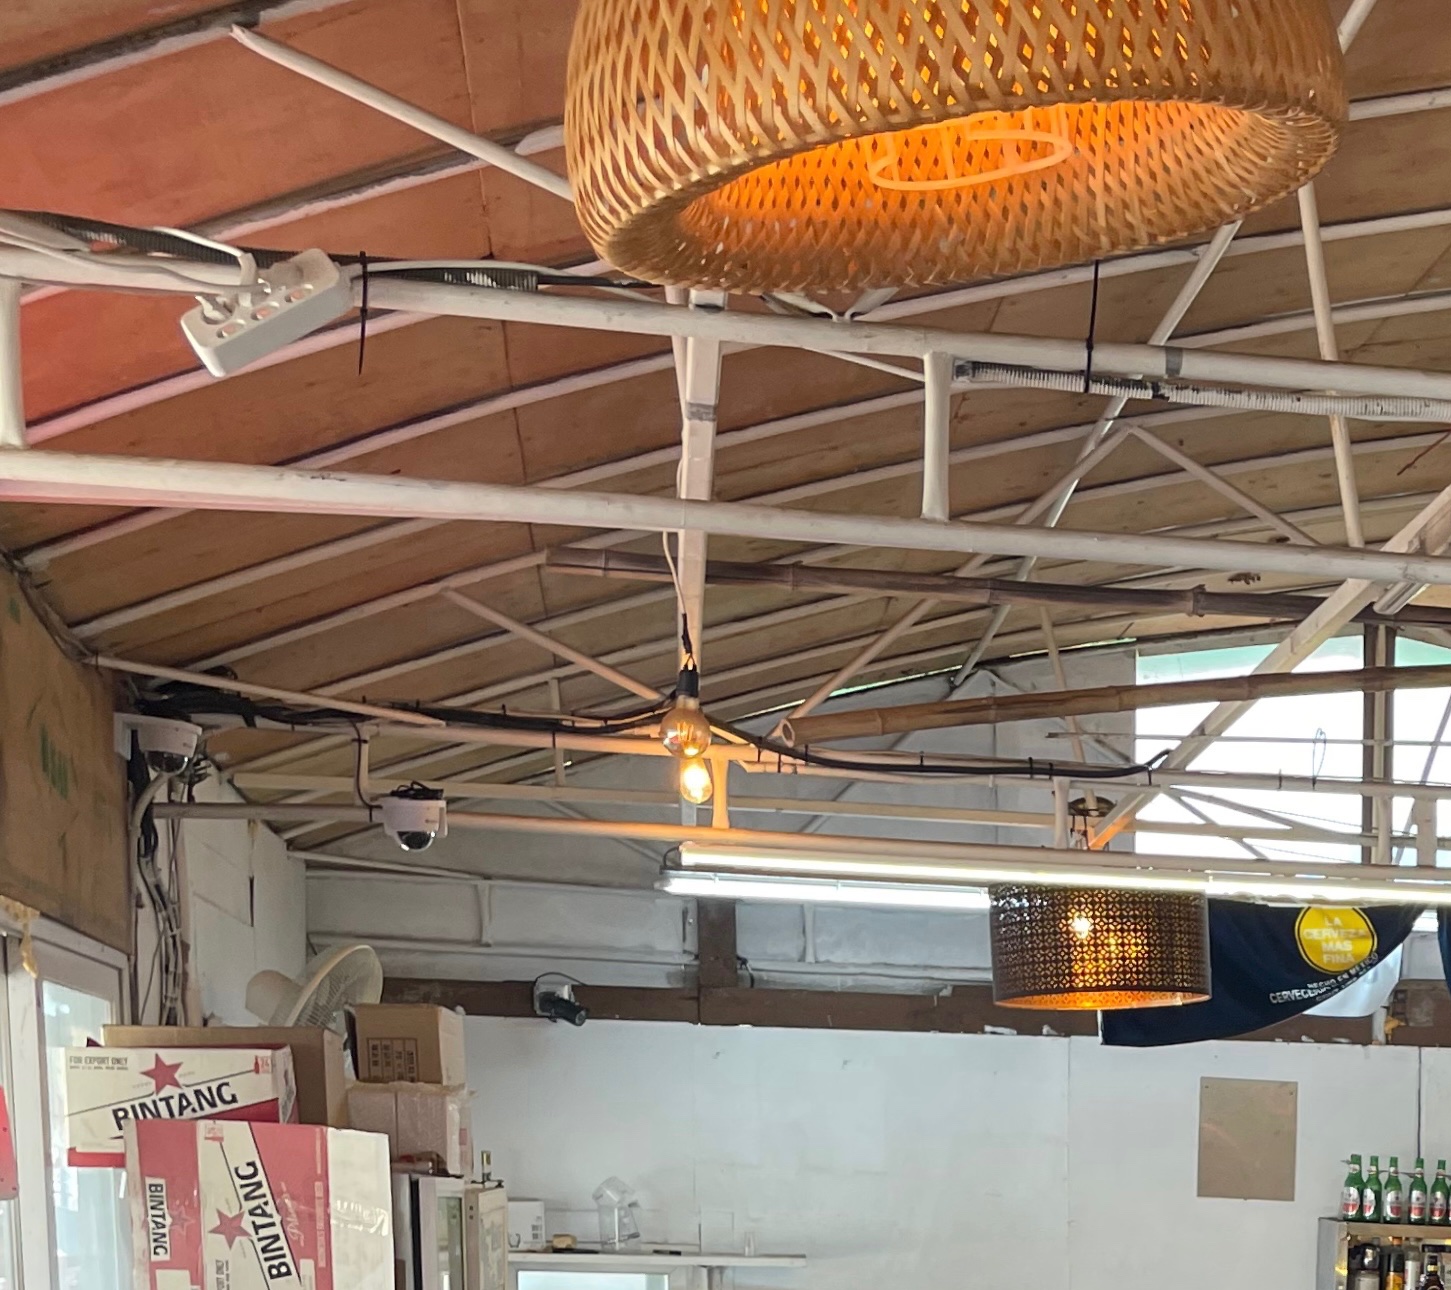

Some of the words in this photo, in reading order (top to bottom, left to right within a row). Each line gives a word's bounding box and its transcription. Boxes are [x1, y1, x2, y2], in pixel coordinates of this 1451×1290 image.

[112, 1082, 238, 1131] BINTANG
[148, 1183, 168, 1256] BINTANG
[234, 1160, 292, 1280] BINTANG
